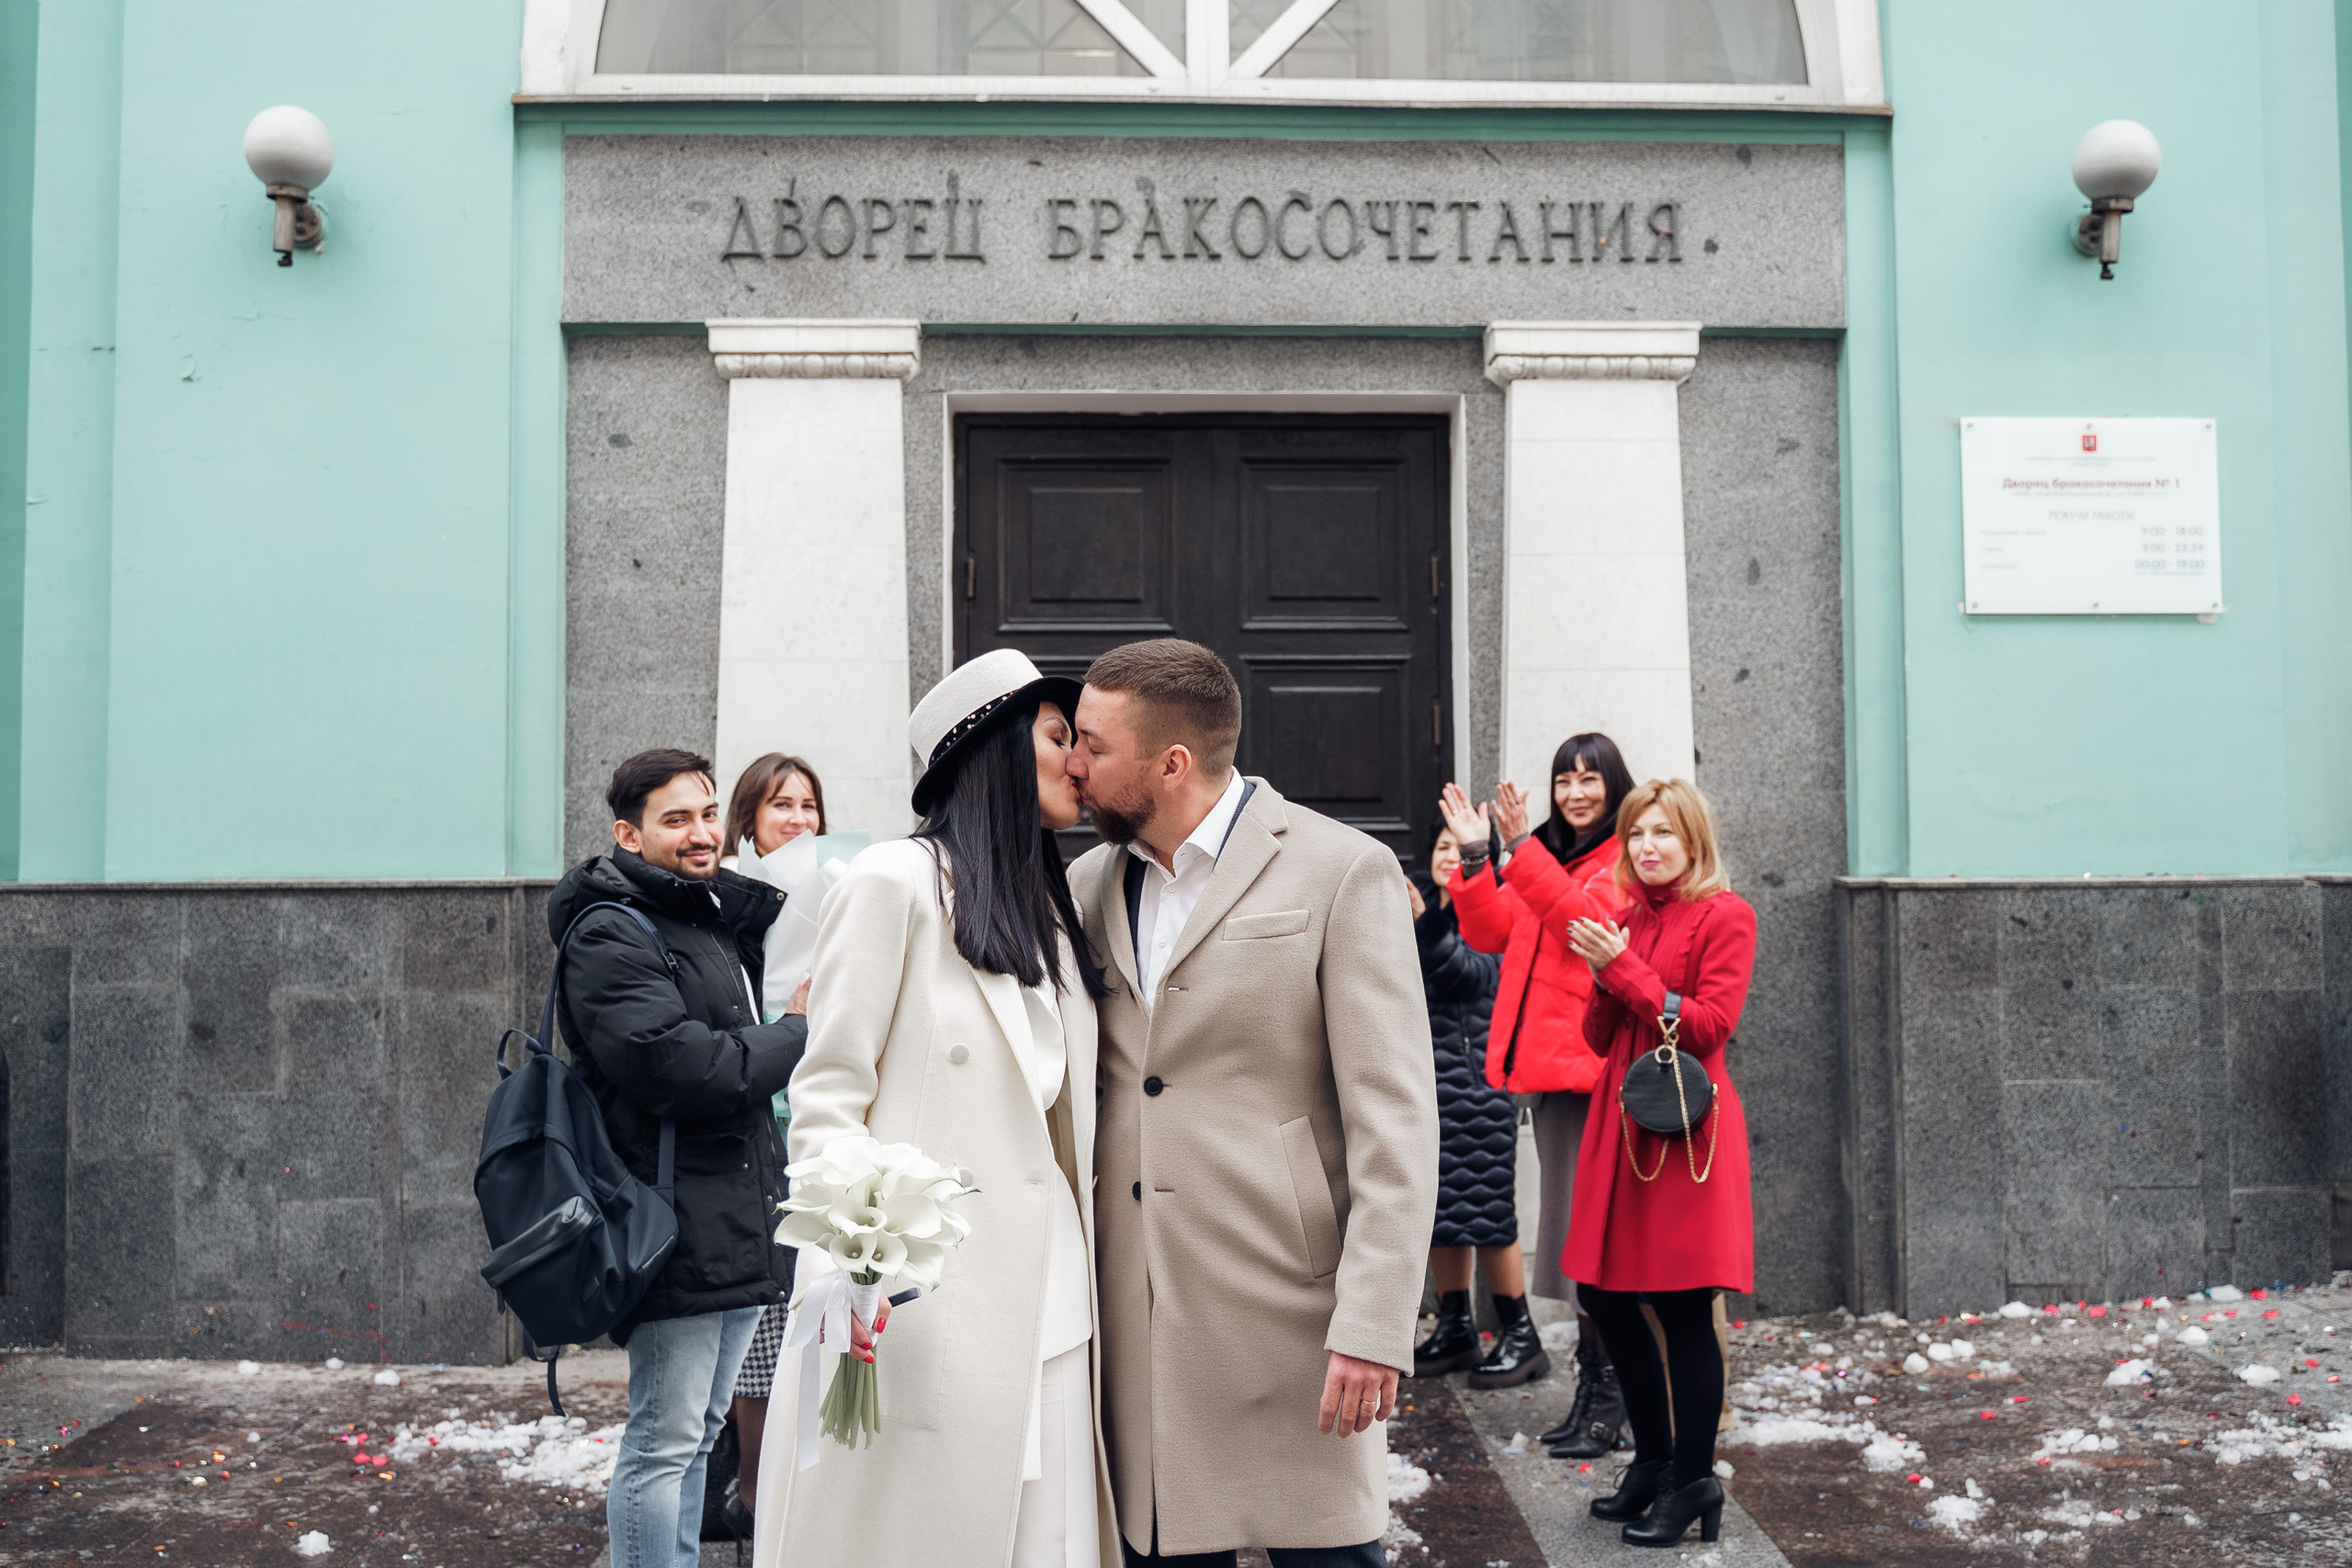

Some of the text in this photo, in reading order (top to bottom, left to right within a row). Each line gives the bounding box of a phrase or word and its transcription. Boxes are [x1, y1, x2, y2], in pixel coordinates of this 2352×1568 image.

[721, 194, 1682, 265] ДВОРЕЦ БРАКОСОЧЕТАНИЯ
[2002, 478, 2050, 491] Дворец
[2052, 478, 2153, 491] бракосочетания
